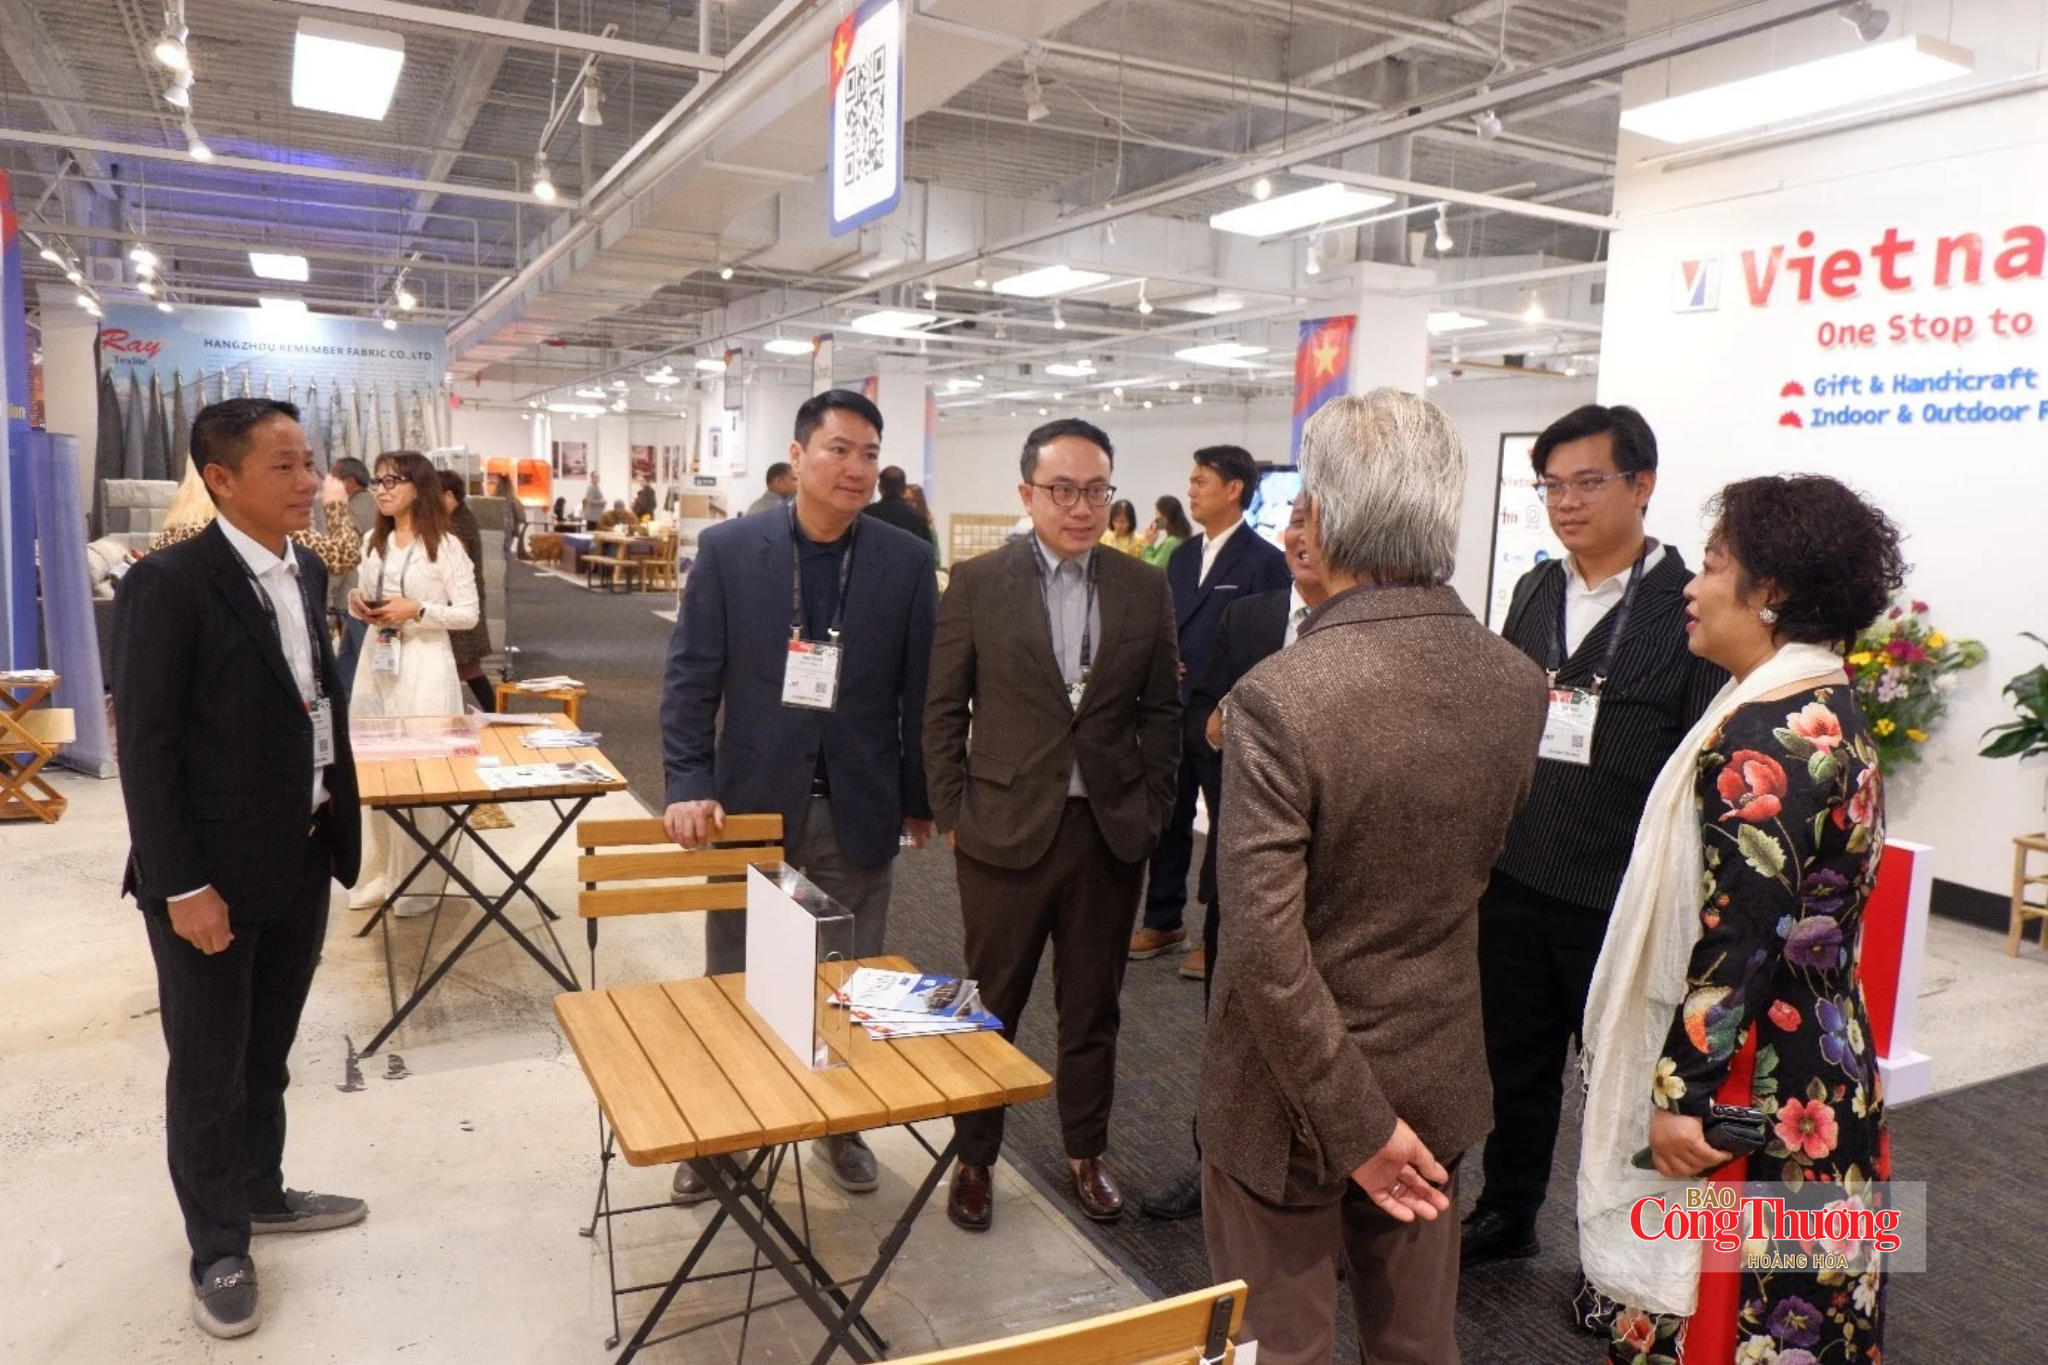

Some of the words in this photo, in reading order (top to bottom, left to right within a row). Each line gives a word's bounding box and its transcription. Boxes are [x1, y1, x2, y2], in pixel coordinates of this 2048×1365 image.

[1817, 321, 1876, 348] One
[1889, 312, 1975, 343] Stop
[1989, 307, 2034, 336] to
[99, 327, 161, 359] Ray
[204, 338, 276, 352] HANGZHOU
[280, 343, 344, 356] REMEMBER
[347, 347, 387, 359] FABRIC
[1813, 373, 1863, 397] Gift
[1869, 375, 1885, 394] &
[1892, 367, 2039, 395] Handicraft
[1810, 405, 1890, 427] Indoor
[1897, 404, 1913, 424] &
[1922, 400, 2031, 423] Outdoor
